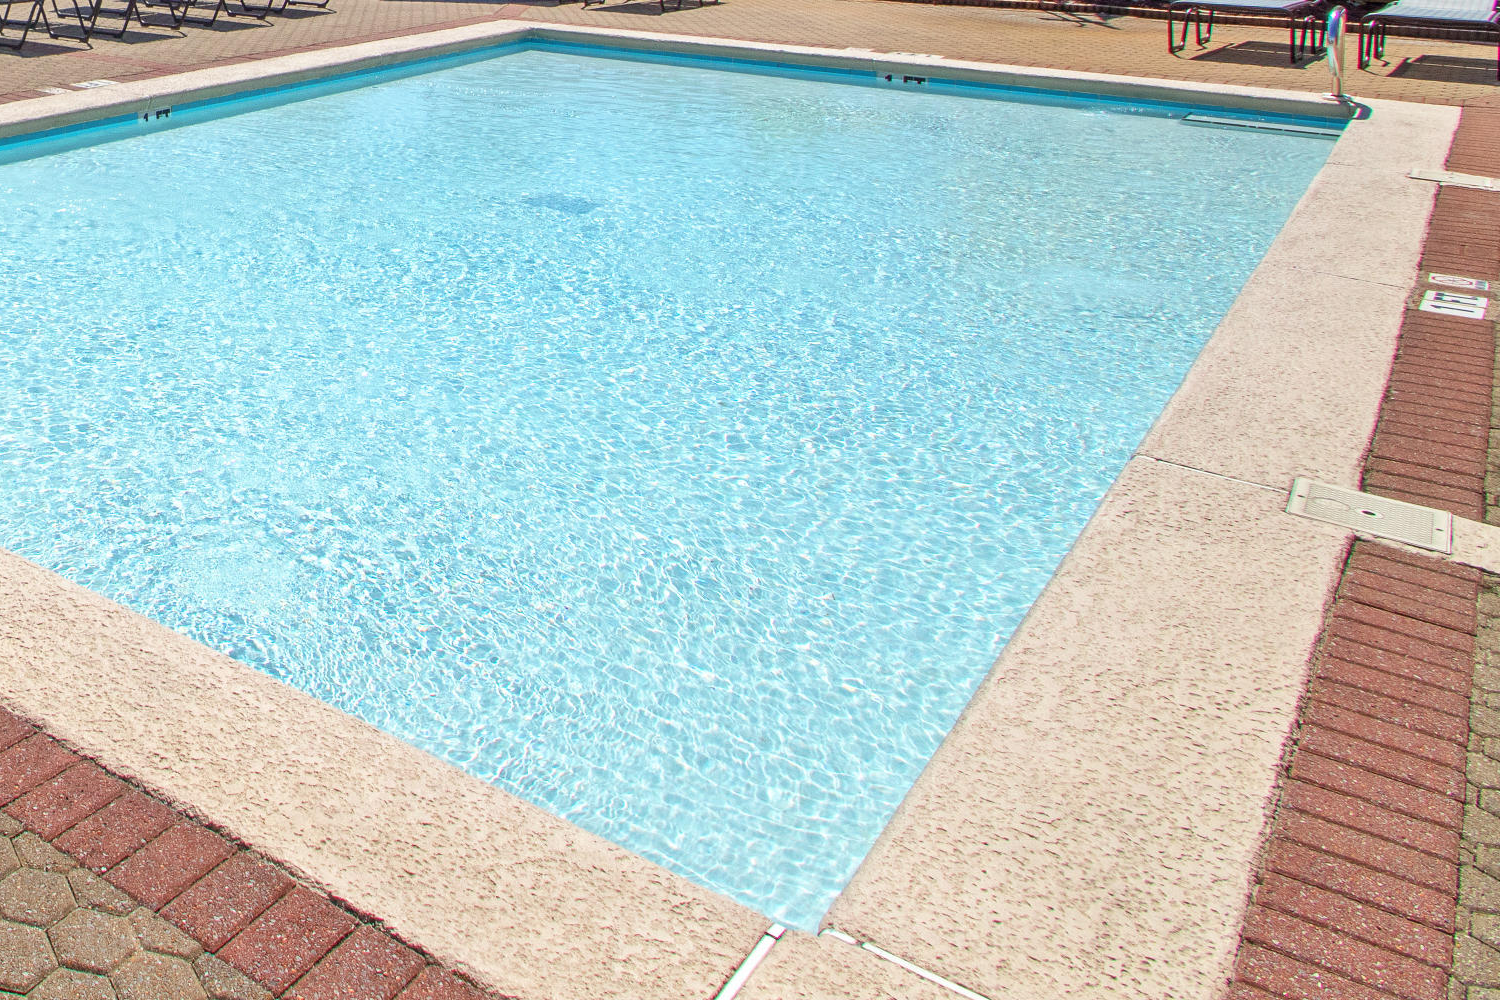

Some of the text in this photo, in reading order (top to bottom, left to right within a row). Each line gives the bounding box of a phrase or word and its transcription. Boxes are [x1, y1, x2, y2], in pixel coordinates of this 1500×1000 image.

[885, 74, 926, 84] 1 FT
[143, 108, 171, 122] 1 FT
